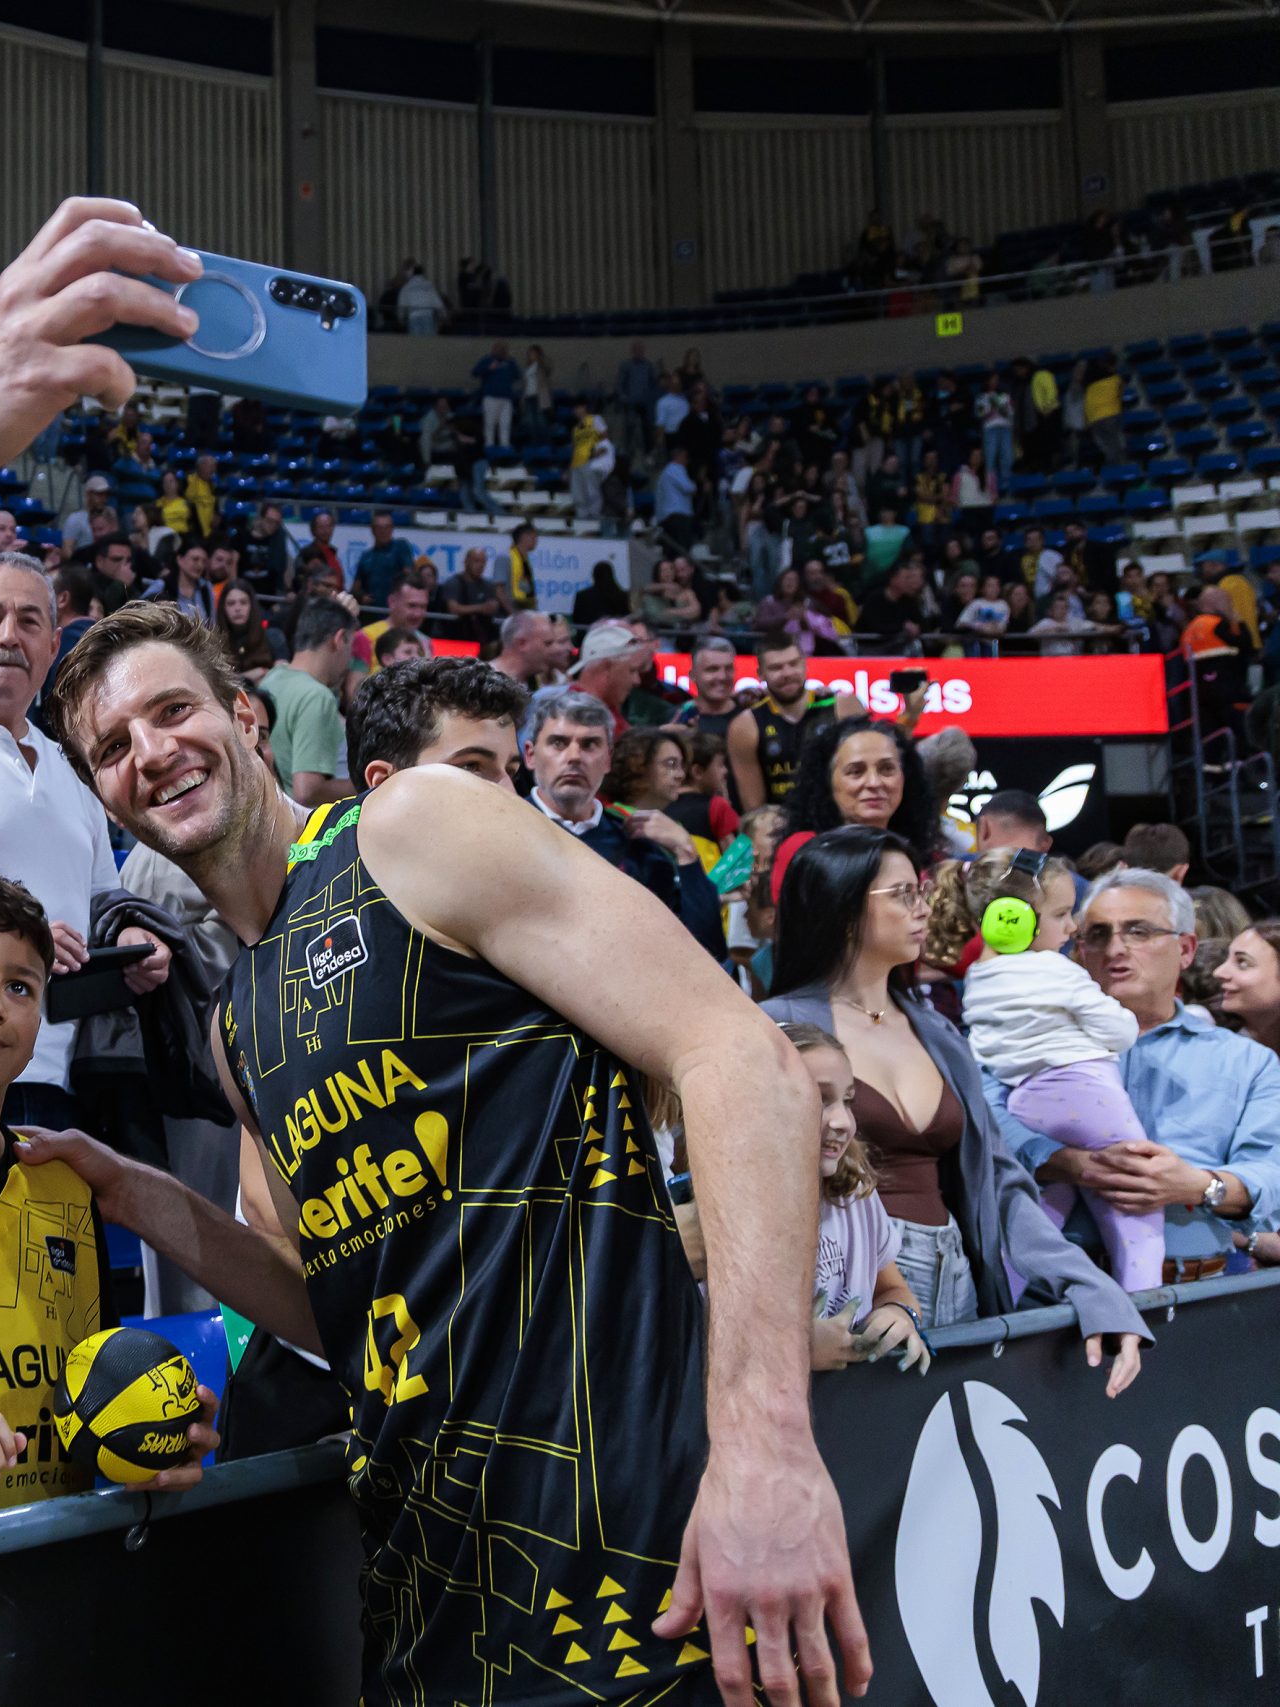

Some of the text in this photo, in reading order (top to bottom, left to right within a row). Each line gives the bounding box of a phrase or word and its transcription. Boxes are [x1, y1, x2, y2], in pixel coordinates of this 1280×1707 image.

[312, 947, 333, 969] liga
[315, 945, 362, 980] endesa
[301, 996, 313, 1014] A
[305, 1034, 323, 1056] Hi
[271, 1049, 428, 1177] LAGUNA
[299, 1111, 452, 1239] erife!
[340, 1196, 437, 1257] emociones
